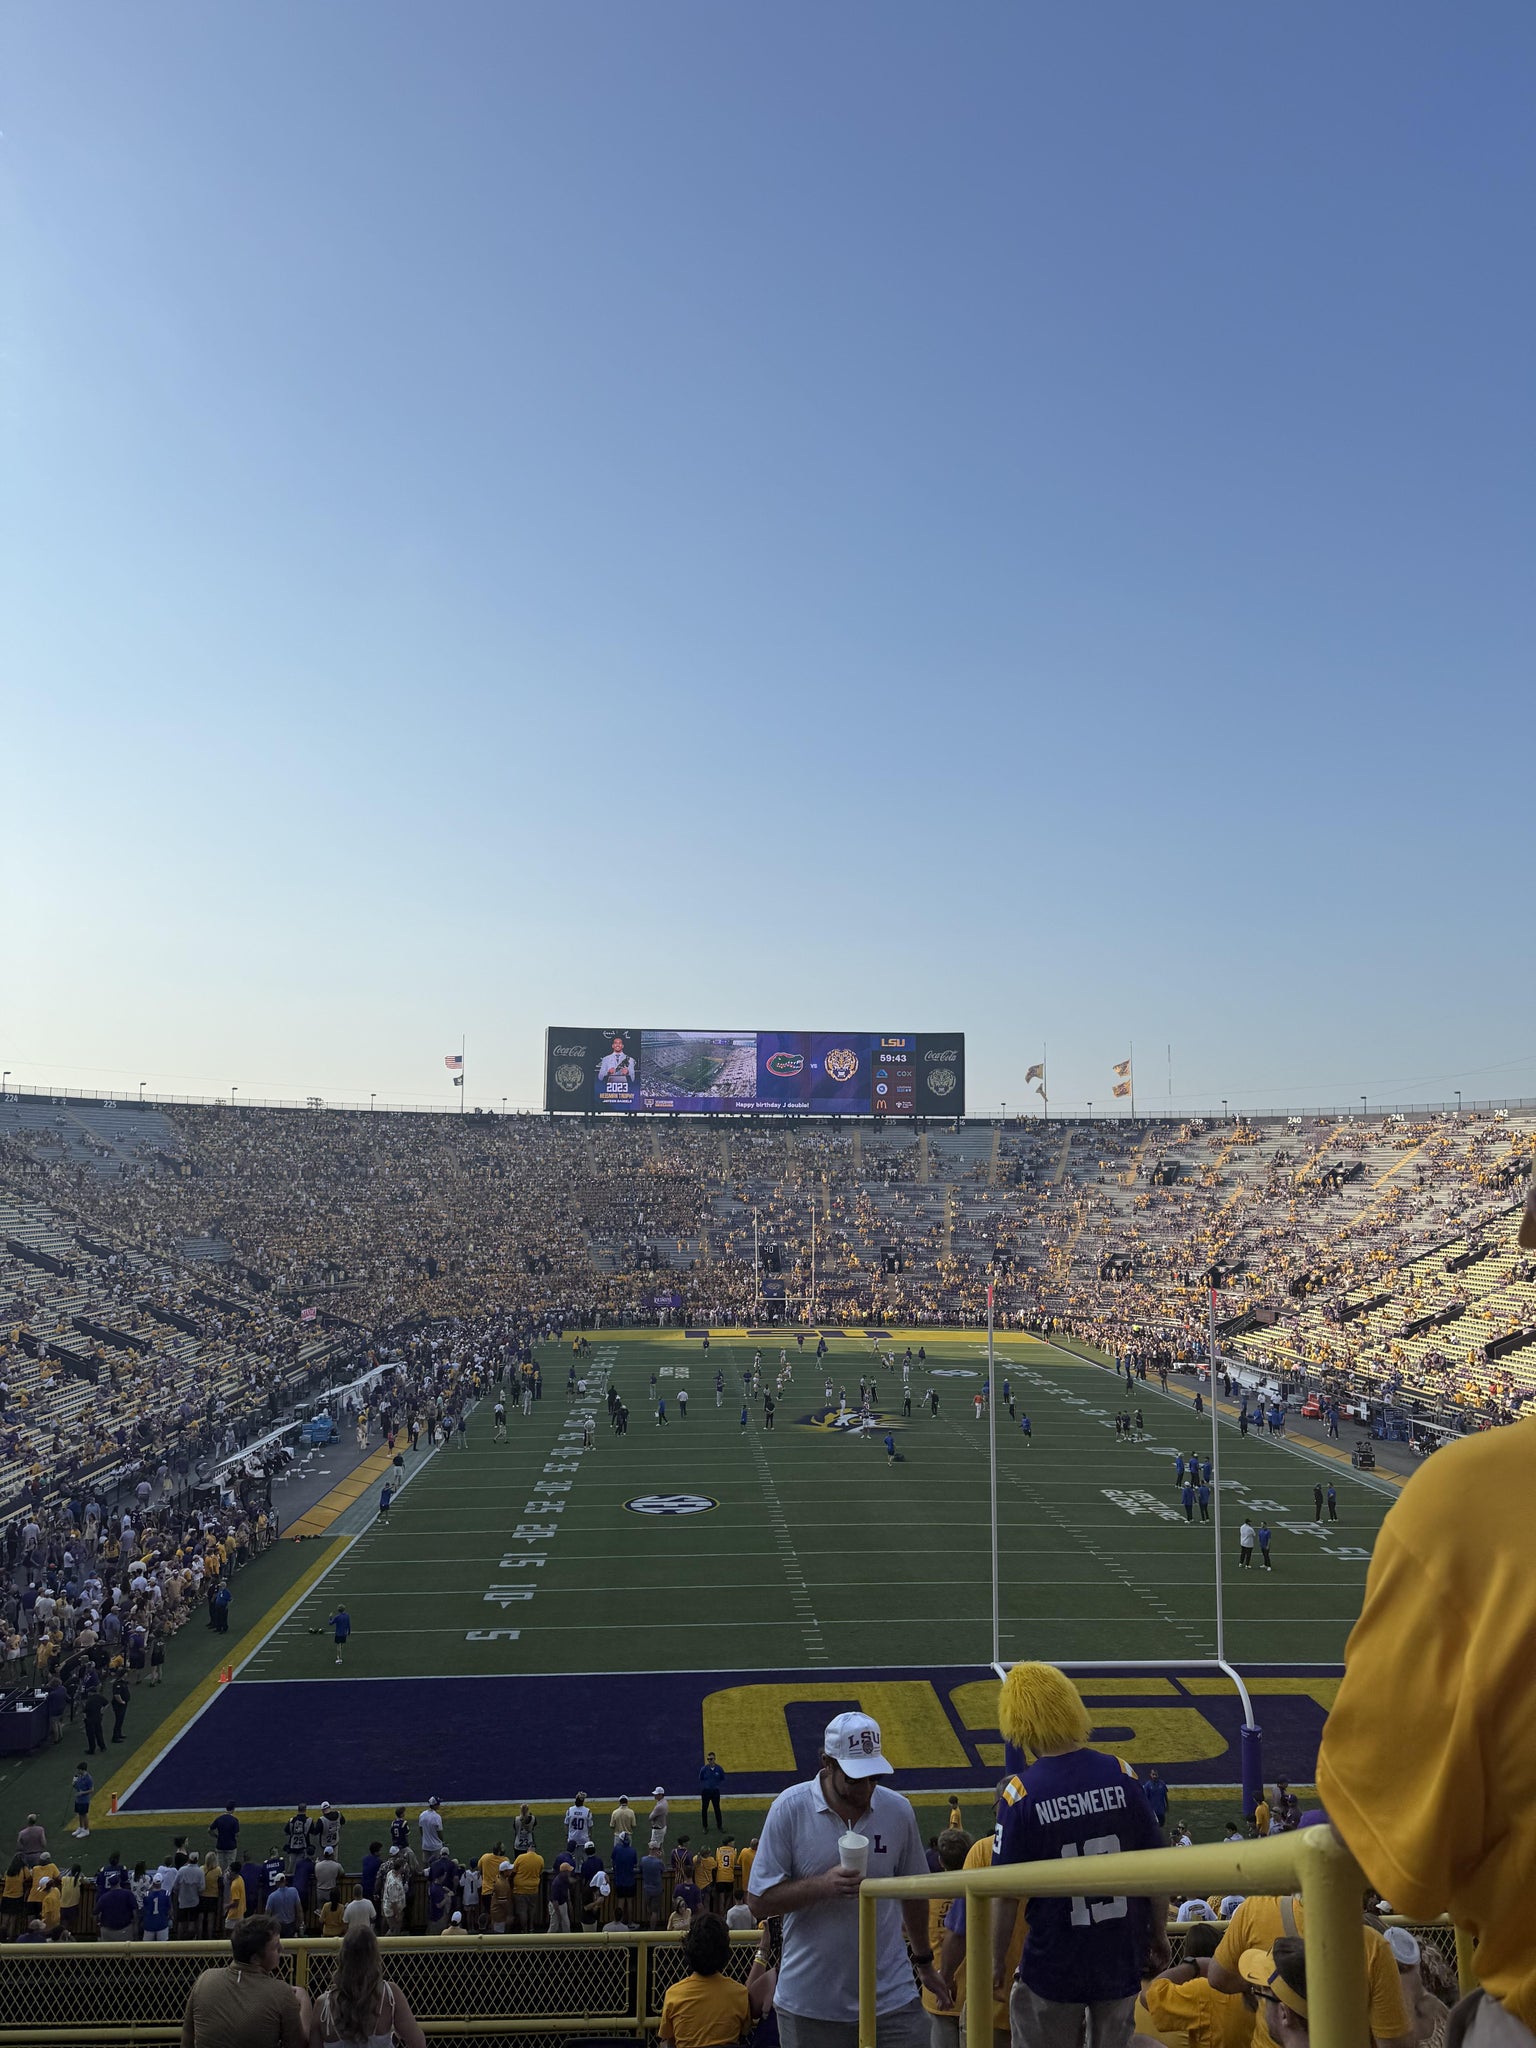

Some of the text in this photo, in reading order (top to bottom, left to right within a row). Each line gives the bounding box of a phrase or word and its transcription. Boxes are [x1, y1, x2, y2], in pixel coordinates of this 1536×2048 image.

[881, 1038, 905, 1047] LSU
[880, 1054, 907, 1062] 59:43
[606, 1082, 628, 1093] 2023
[5, 1094, 18, 1103] 224
[104, 1100, 117, 1109] 225
[736, 1101, 754, 1109] Happy
[756, 1101, 781, 1109] birthday
[1494, 1109, 1509, 1117] 242
[1287, 1116, 1302, 1125] 240
[533, 1480, 573, 1492] 30
[523, 1500, 566, 1514] 25
[511, 1523, 558, 1539] 20
[499, 1552, 548, 1567] 15
[483, 1583, 537, 1601] 10
[465, 1630, 521, 1641] 5
[847, 1730, 880, 1749] LSU
[1035, 1785, 1127, 1826] NUSSMEIER
[571, 1817, 585, 1831] 40
[293, 1835, 304, 1846] 25
[518, 1838, 529, 1847] 23
[874, 1834, 887, 1853] L
[722, 1855, 730, 1867] 9
[268, 1870, 278, 1886] 5
[152, 1897, 160, 1915] 1
